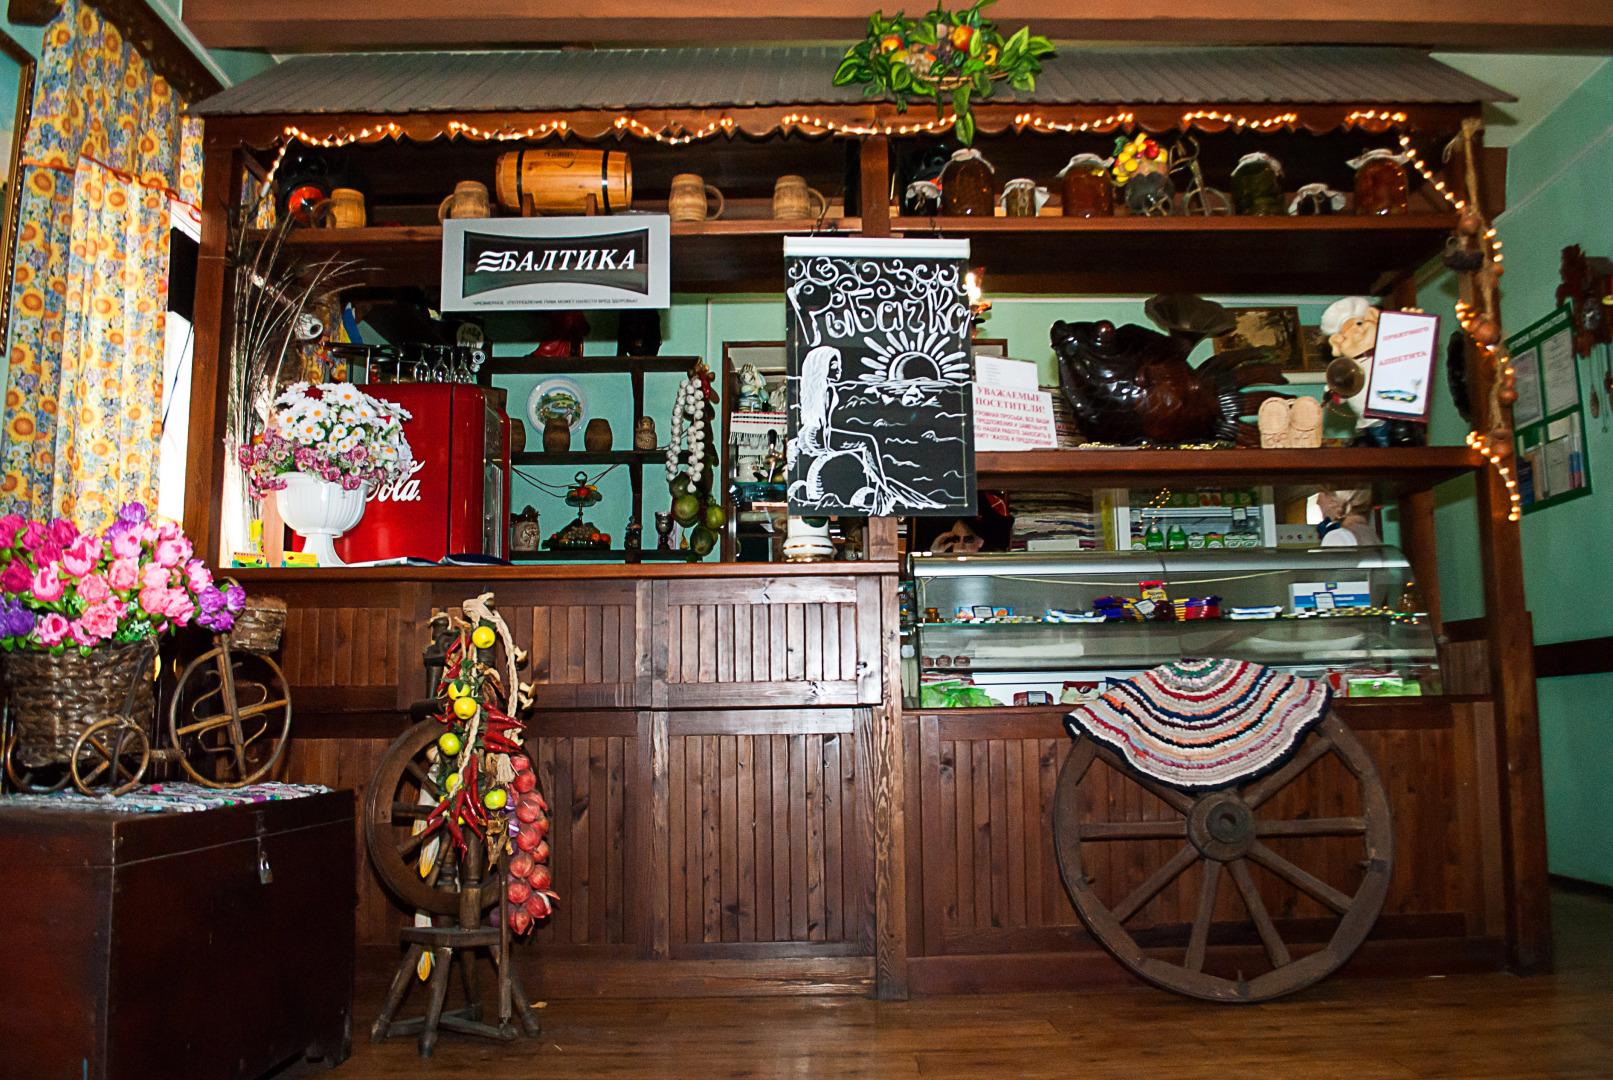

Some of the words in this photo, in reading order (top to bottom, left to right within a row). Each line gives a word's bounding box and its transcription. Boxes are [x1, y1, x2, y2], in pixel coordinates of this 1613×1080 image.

[499, 249, 635, 271] БАЛТИКА
[977, 386, 1041, 402] УВАЖАЕМЫЕ
[976, 398, 1045, 413] ПОСЕТИТЕЛИ!
